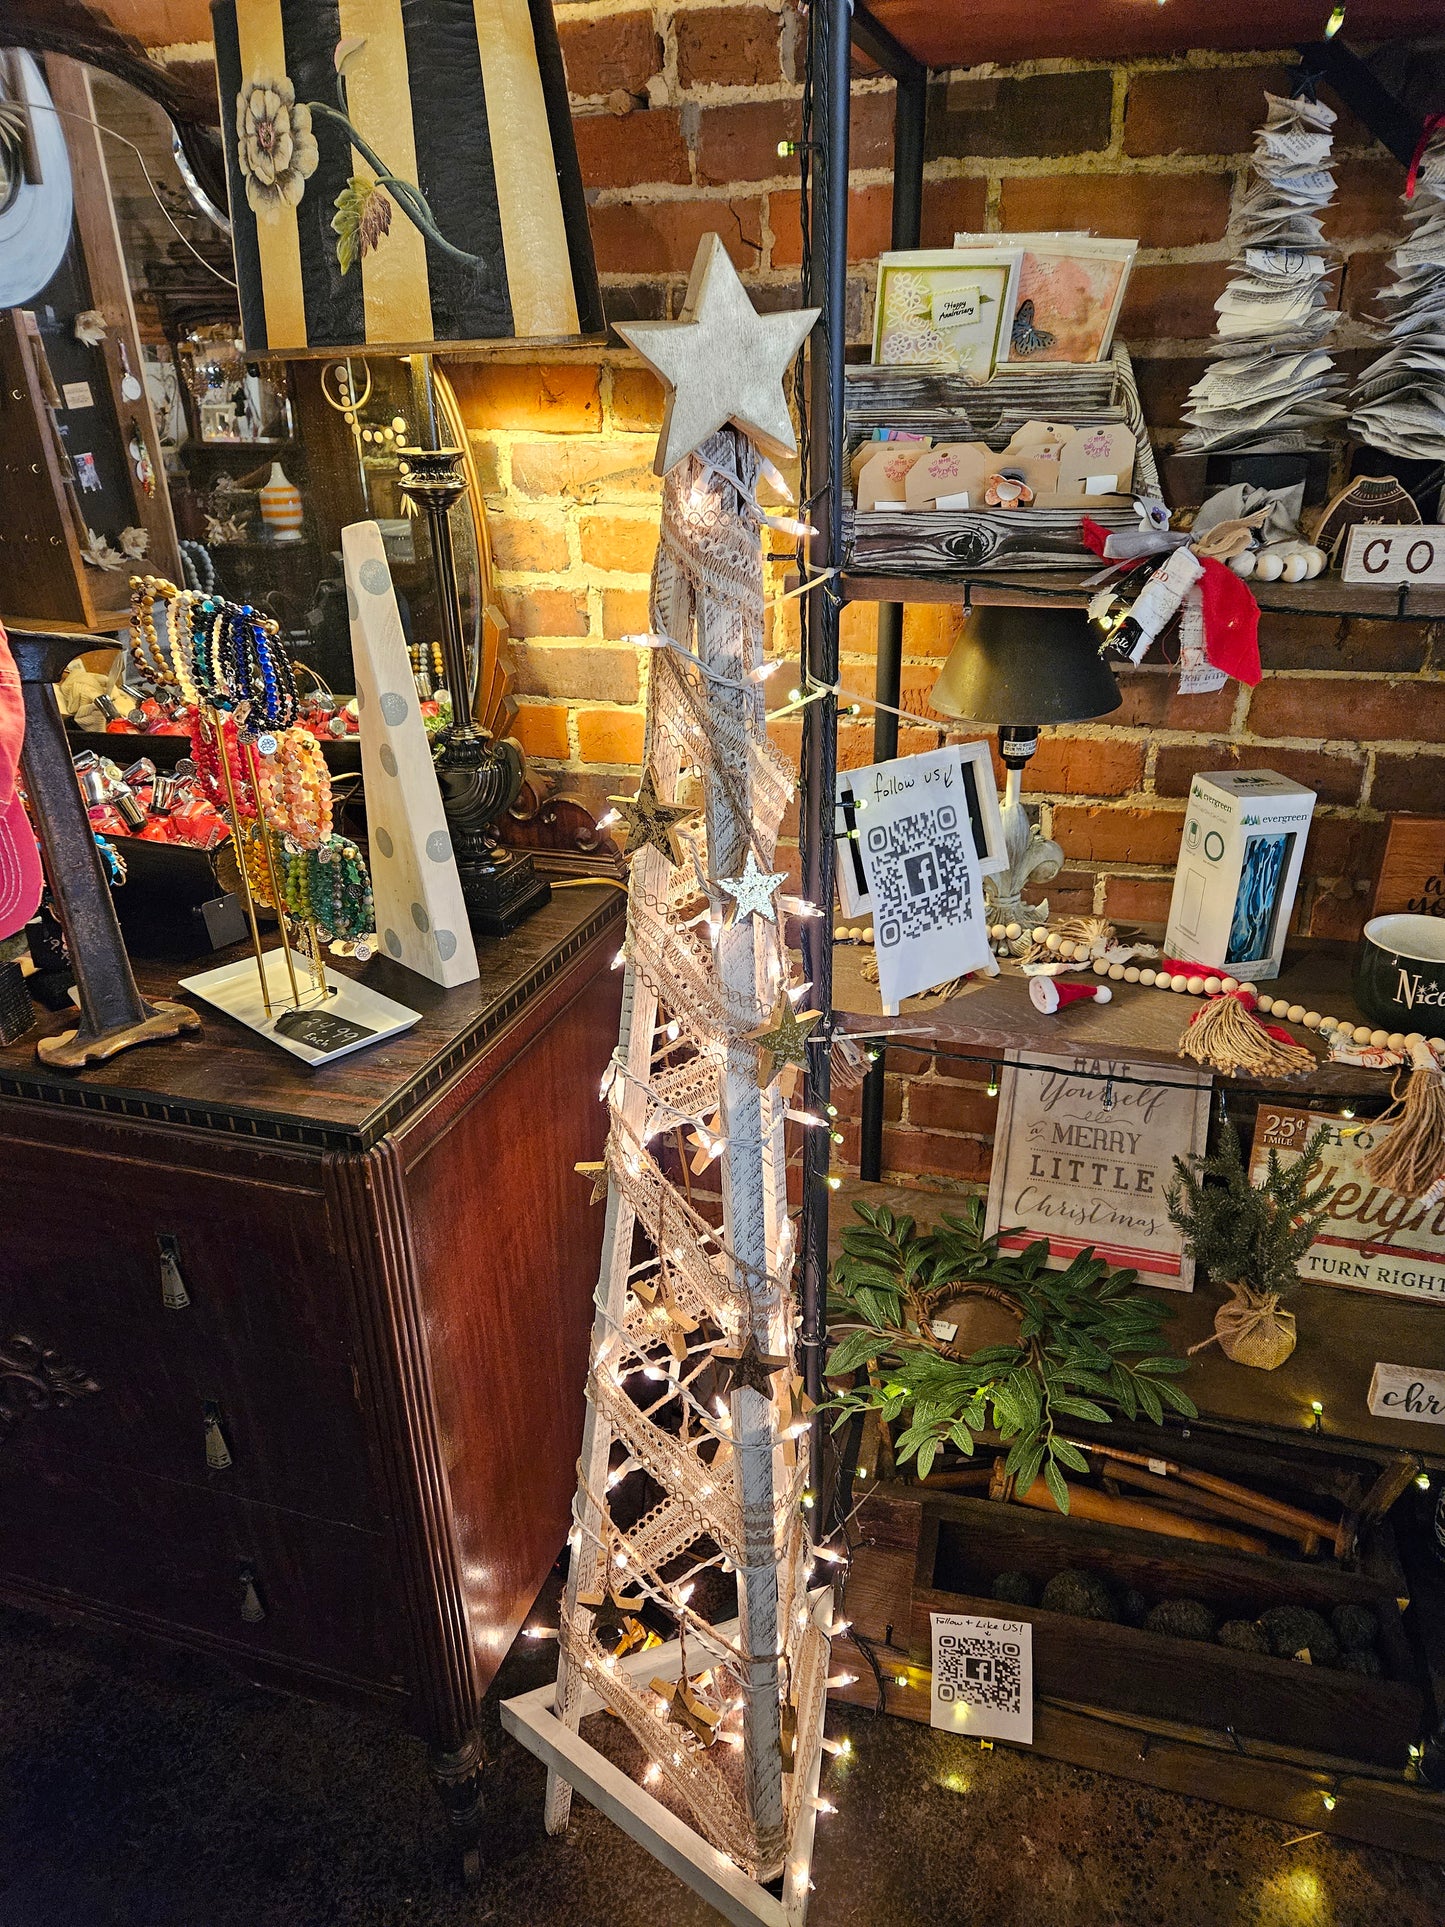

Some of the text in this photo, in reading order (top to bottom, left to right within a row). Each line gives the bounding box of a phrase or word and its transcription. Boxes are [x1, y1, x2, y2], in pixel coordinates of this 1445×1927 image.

[938, 307, 975, 321] Anniversary
[943, 300, 967, 311] Happy
[874, 772, 915, 802] follow
[1203, 793, 1232, 813] evergreen
[1262, 813, 1308, 825] evergreen
[301, 1018, 359, 1043] 24.99
[303, 1032, 330, 1047] Each
[1051, 1122, 1142, 1155] MERRY
[1270, 1137, 1293, 1147] MILE
[1030, 1154, 1155, 1194] LITTLE
[1309, 1256, 1445, 1293] TURN RIGHT
[935, 1617, 963, 1627] Follow
[975, 1621, 999, 1631] Like
